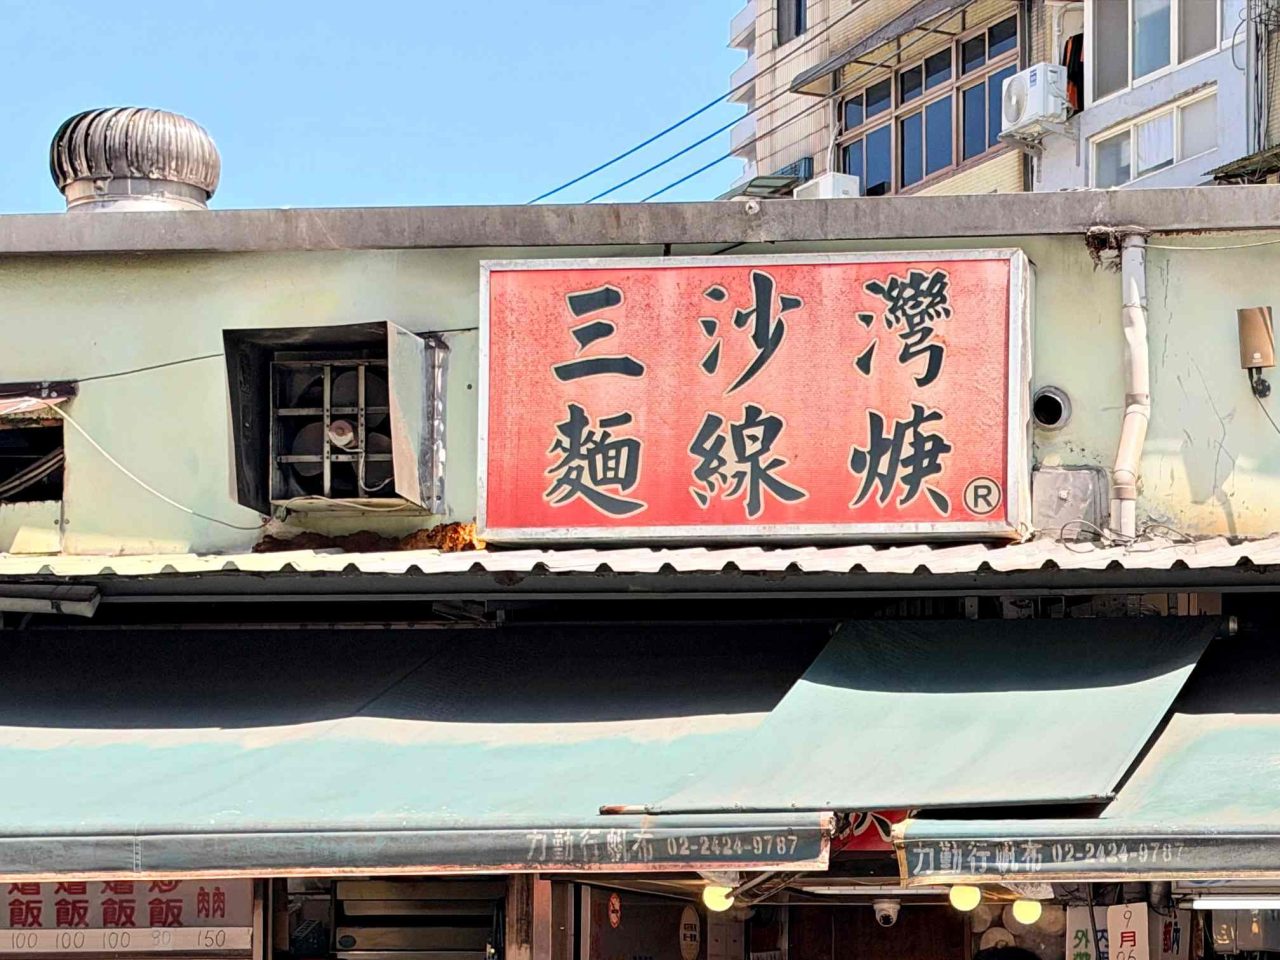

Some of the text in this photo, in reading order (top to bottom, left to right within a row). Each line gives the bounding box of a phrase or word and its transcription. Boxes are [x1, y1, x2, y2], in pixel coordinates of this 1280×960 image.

[551, 267, 953, 395] 三沙灣
[544, 402, 953, 518] 麵線焿
[666, 834, 798, 856] 02-2424-9787
[1051, 842, 1185, 863] 02-2424-9787
[11, 932, 38, 949] 100
[55, 931, 85, 949] 100
[102, 931, 131, 949] 100
[196, 929, 226, 948] 150
